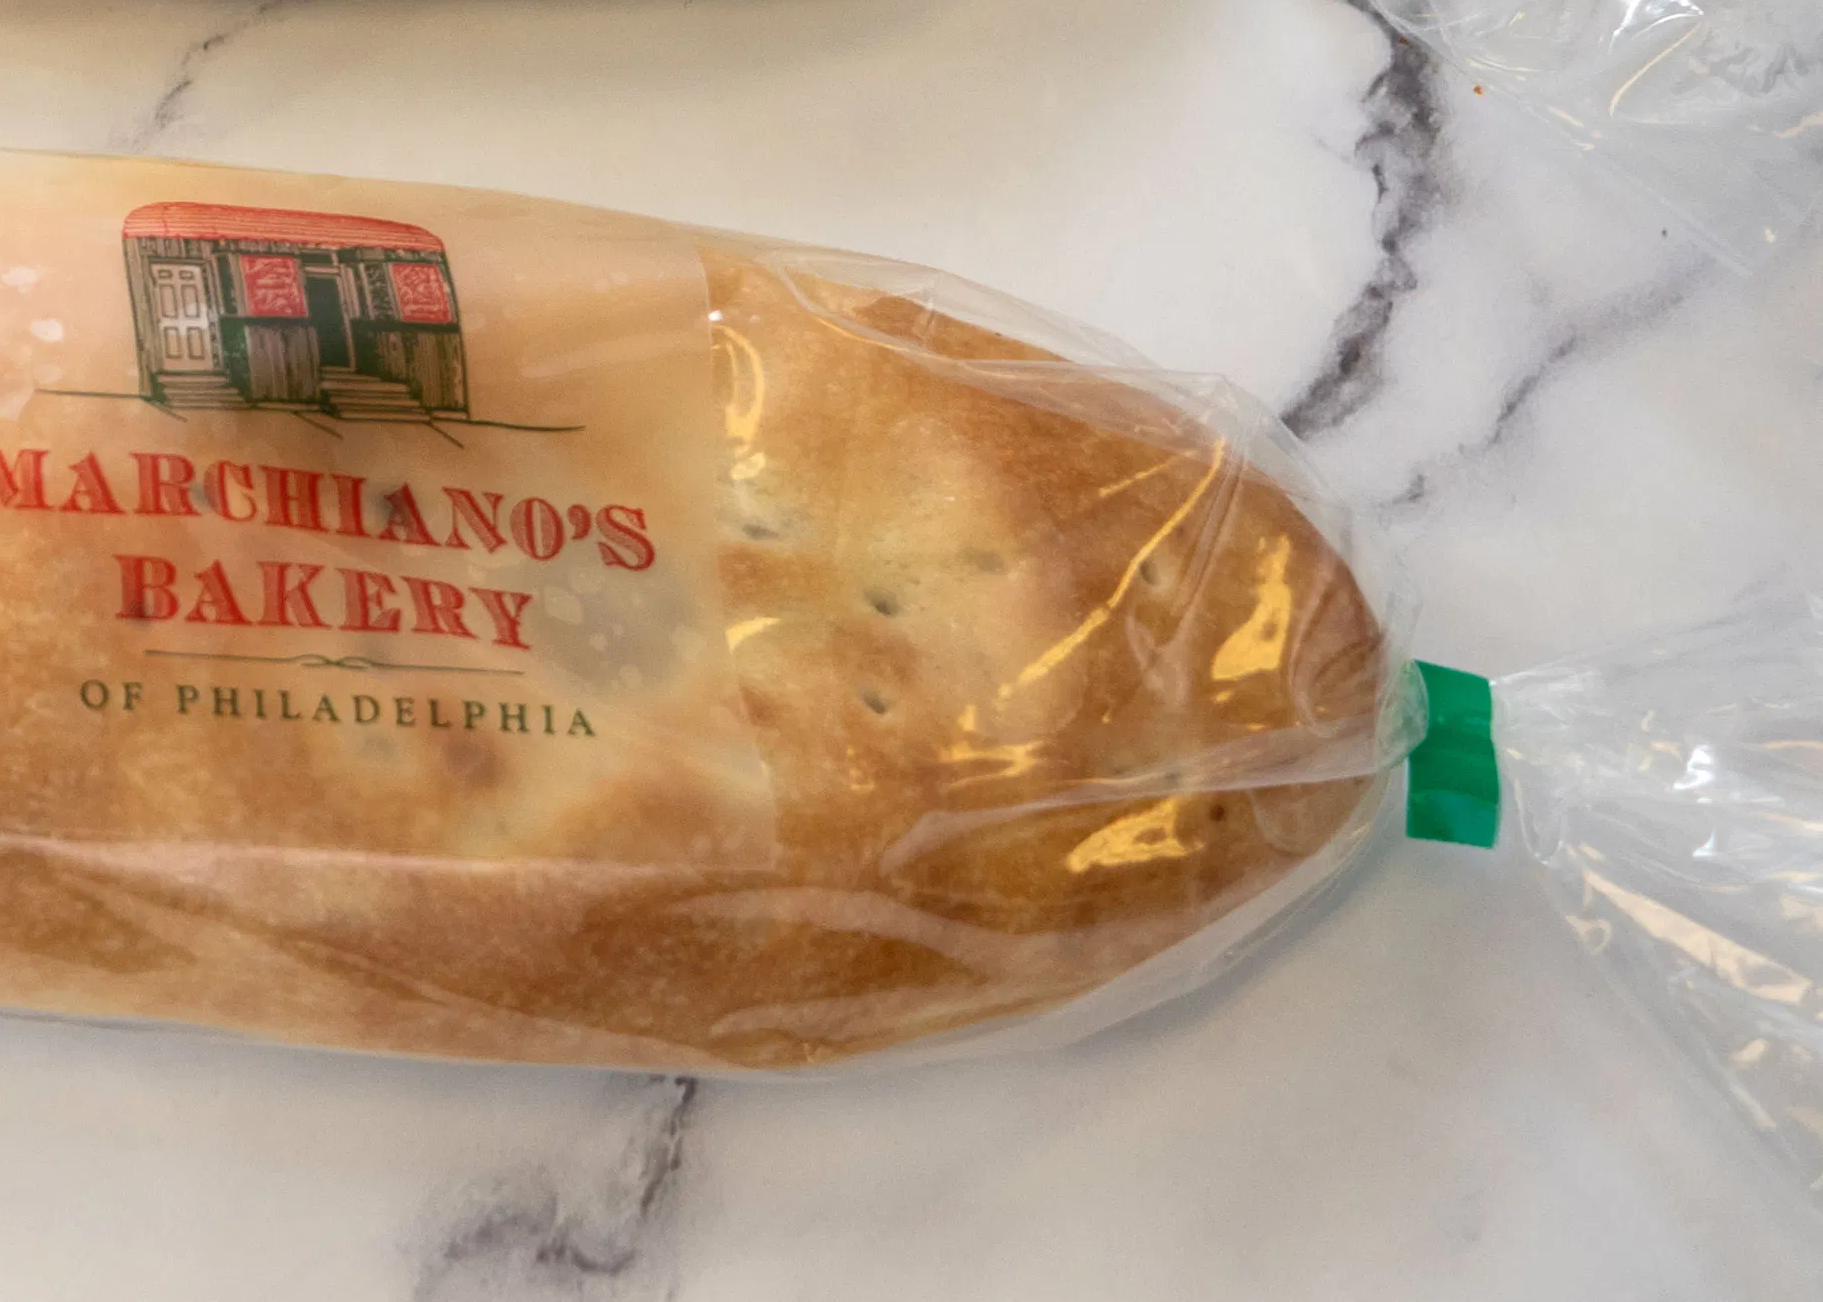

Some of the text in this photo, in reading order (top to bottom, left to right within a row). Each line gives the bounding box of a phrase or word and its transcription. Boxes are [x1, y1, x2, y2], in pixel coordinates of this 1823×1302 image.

[113, 553, 533, 650] BAKERY
[80, 679, 595, 736] OF PHILADELPHIA
